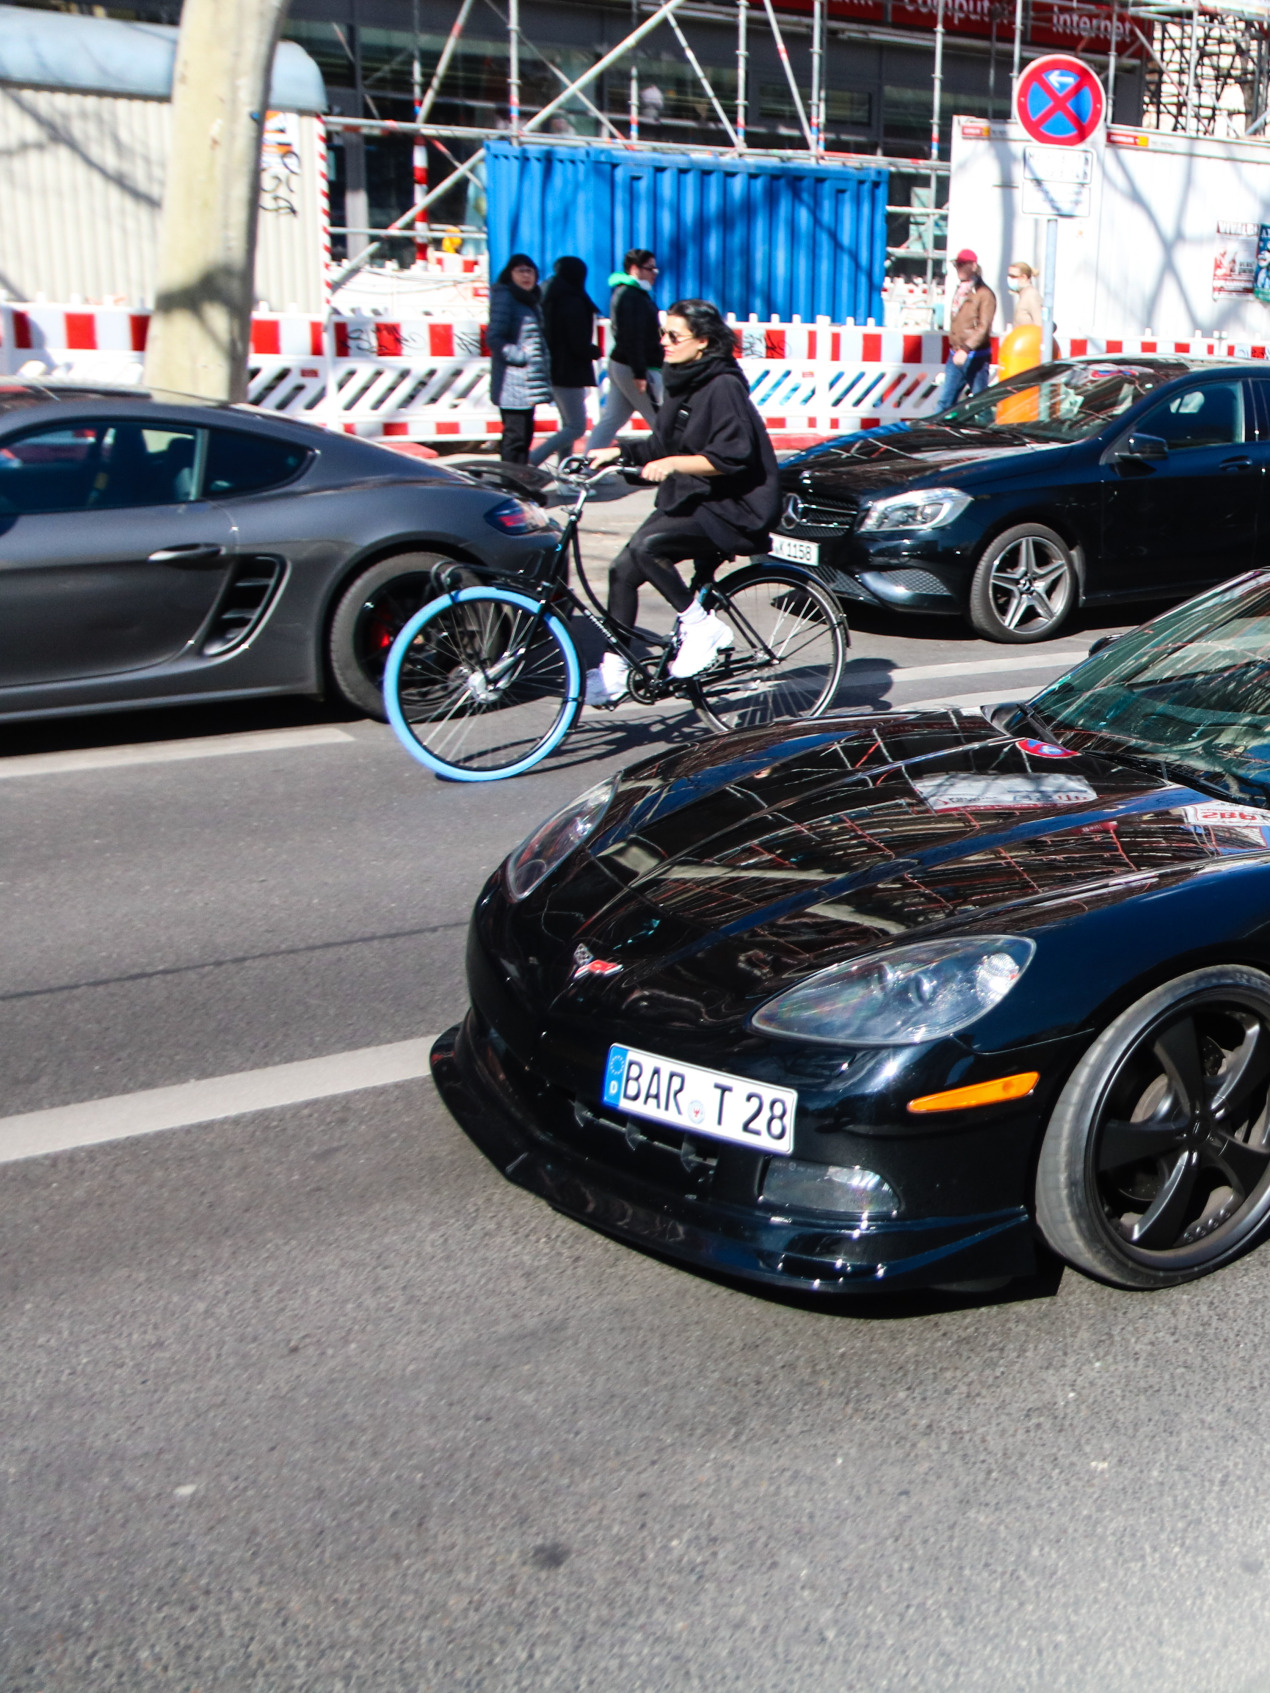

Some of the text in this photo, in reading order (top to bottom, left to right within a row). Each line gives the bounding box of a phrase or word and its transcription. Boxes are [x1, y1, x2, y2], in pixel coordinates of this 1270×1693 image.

[787, 542, 812, 561] 1158
[609, 1081, 618, 1095] D
[623, 1060, 787, 1140] BAR T 28
